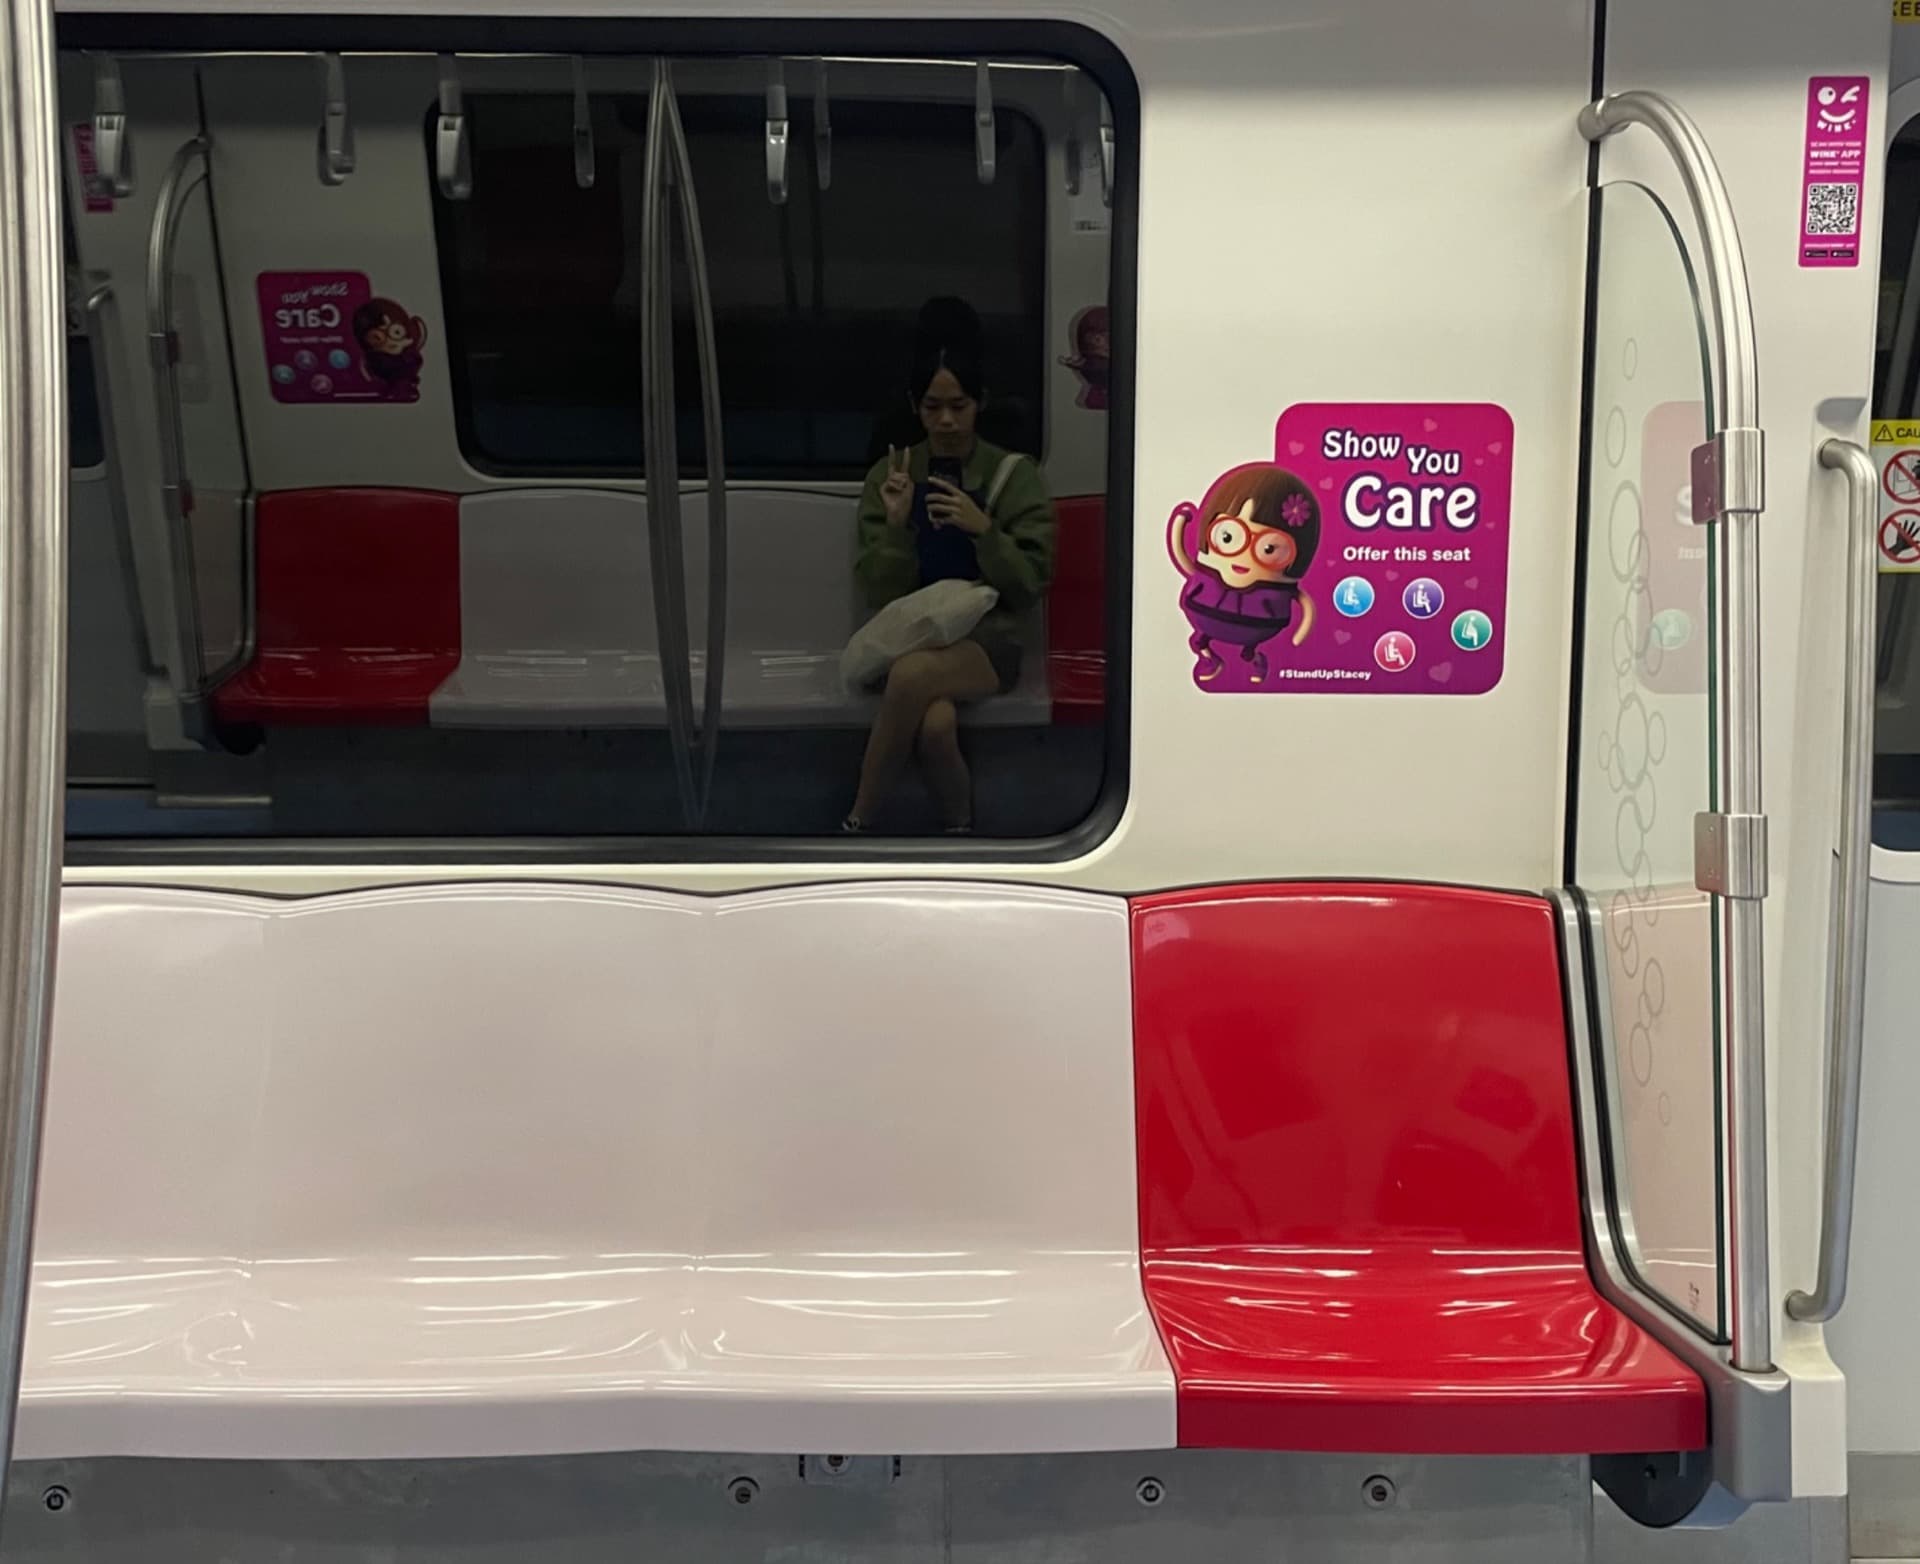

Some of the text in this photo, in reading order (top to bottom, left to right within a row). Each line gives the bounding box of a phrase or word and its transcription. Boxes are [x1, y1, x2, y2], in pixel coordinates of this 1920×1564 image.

[1840, 150, 1861, 158] APP
[1323, 430, 1460, 474] Show You
[1344, 475, 1477, 529] Care
[1343, 546, 1471, 561] Offer this seat
[1279, 669, 1372, 681] #StandUpStacey
